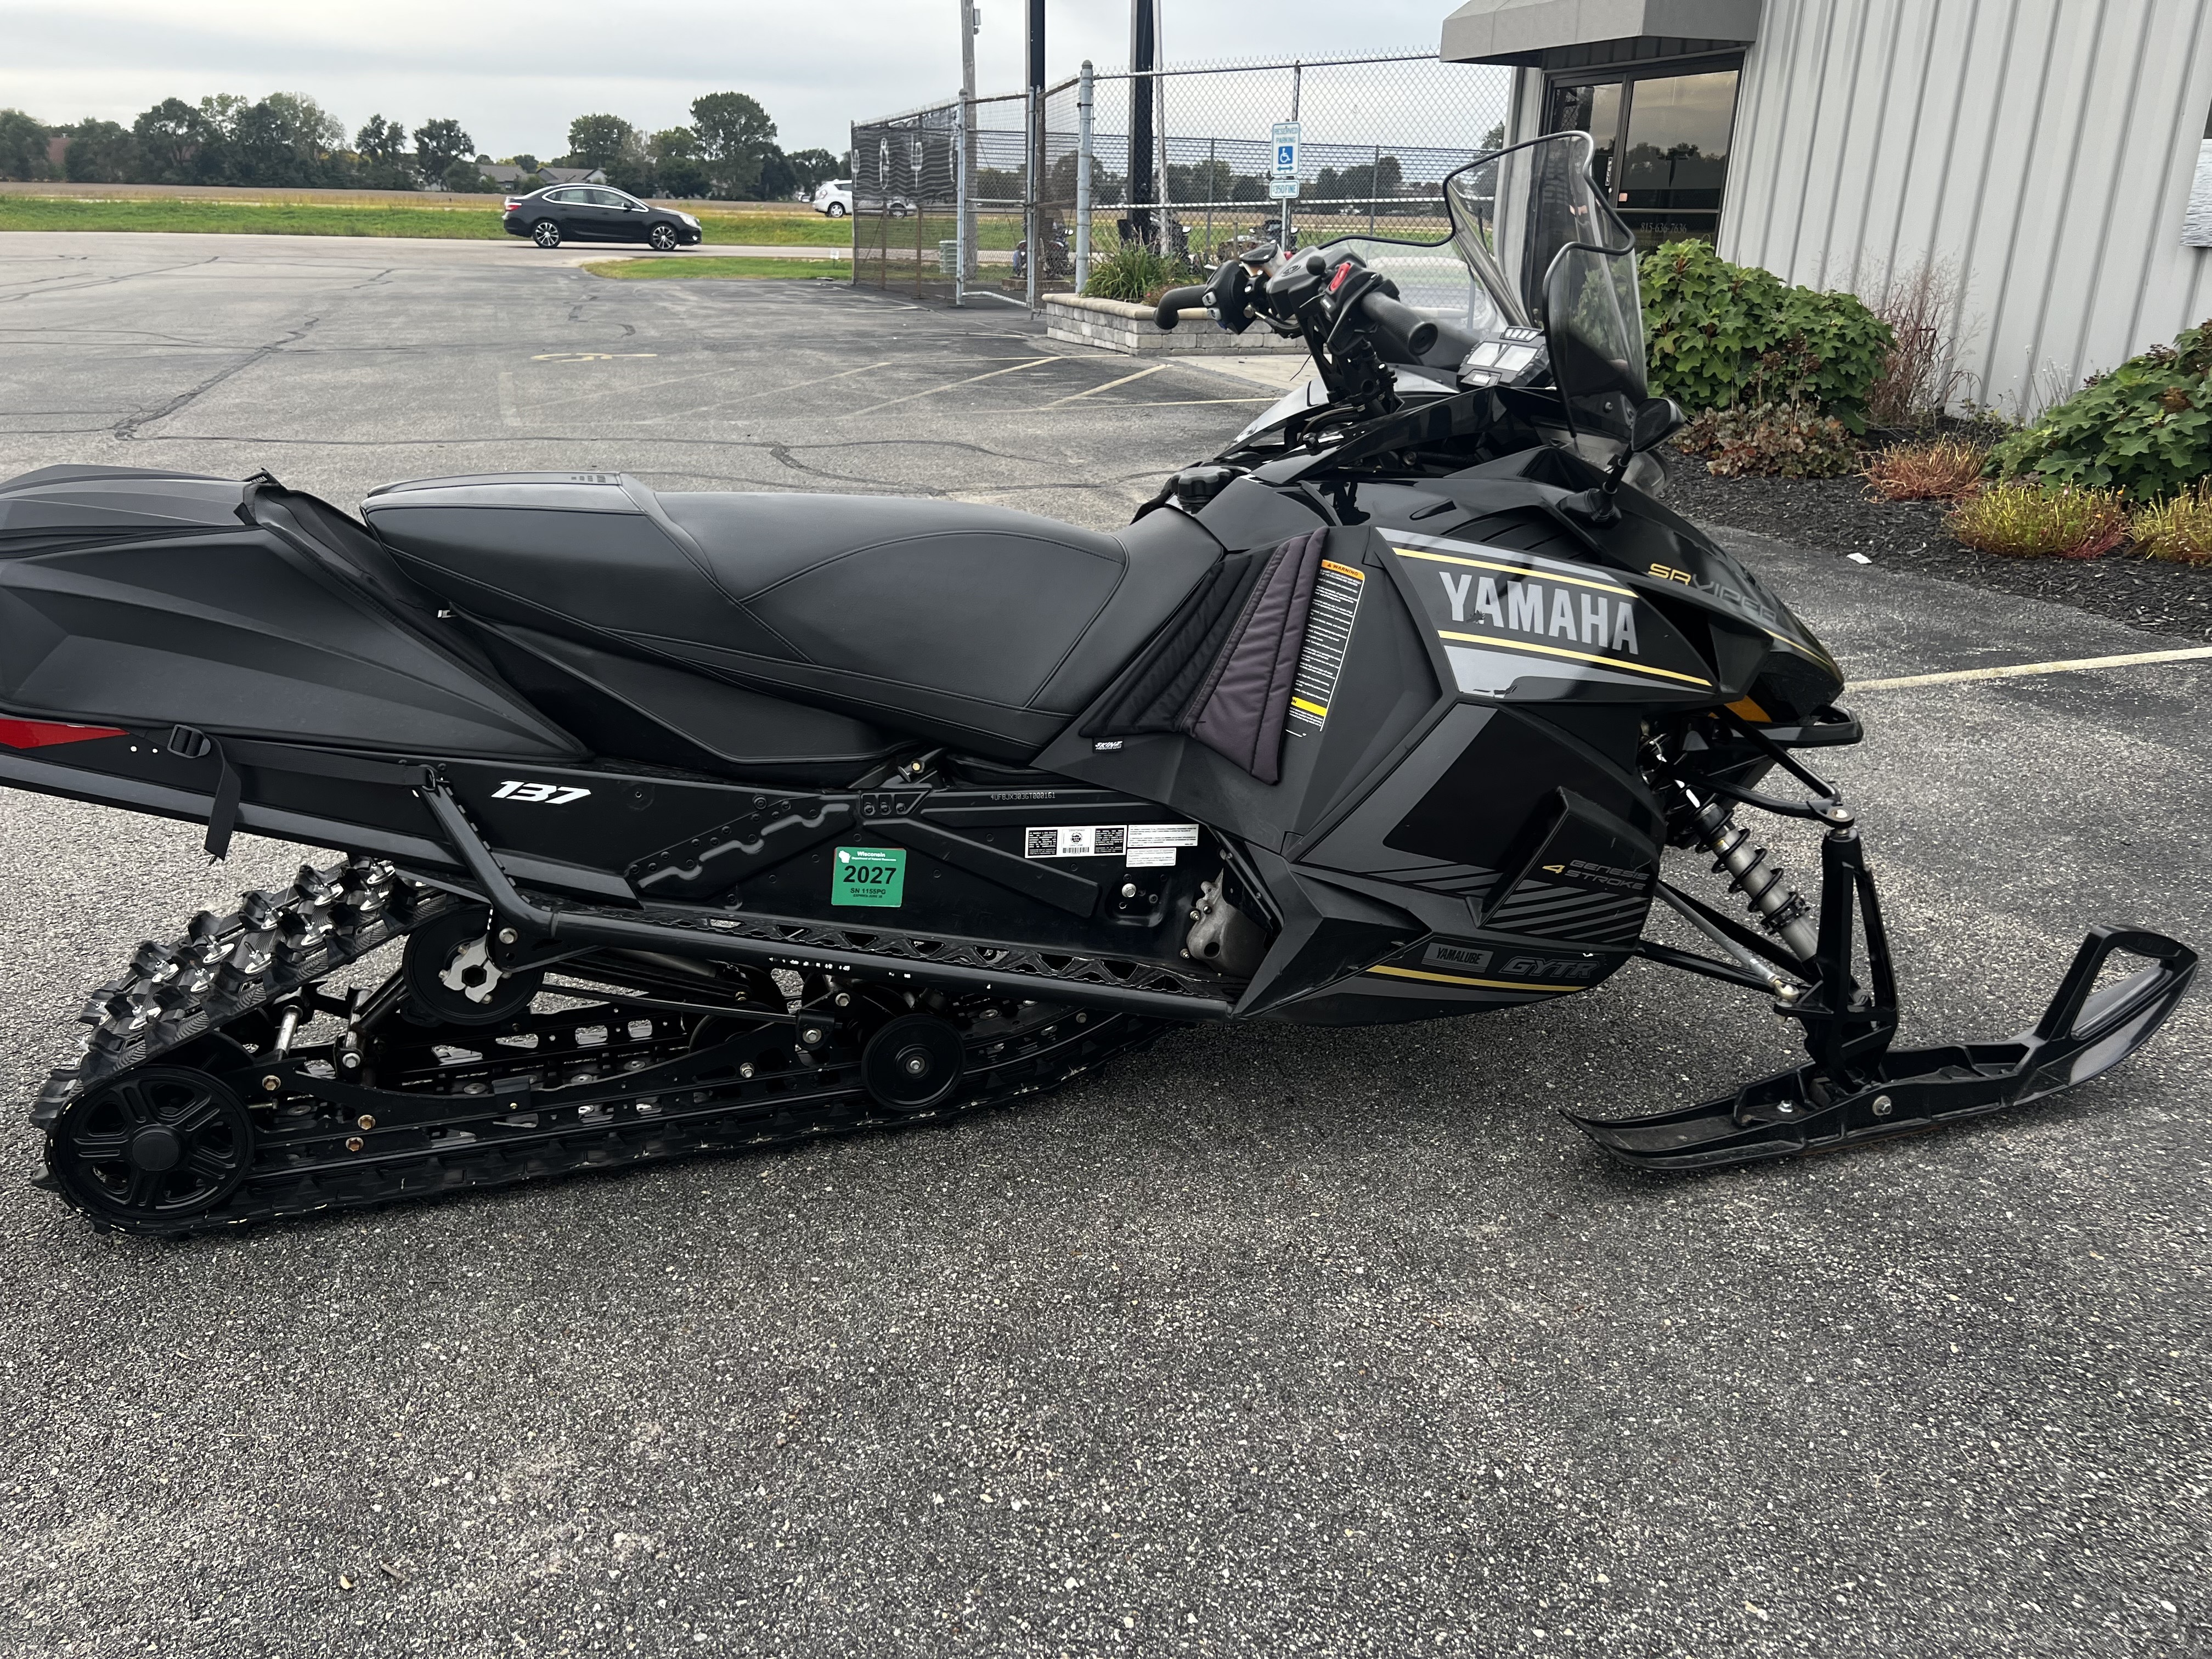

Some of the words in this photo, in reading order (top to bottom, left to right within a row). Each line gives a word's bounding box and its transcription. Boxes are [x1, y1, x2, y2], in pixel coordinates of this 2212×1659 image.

[1285, 184, 1296, 194] FINE
[1640, 222, 1687, 234] 815-636-7636
[1333, 565, 1358, 576] WARNING
[1438, 571, 1639, 655] YAMAHA
[491, 781, 591, 804] 137
[843, 865, 896, 884] 2027
[1542, 864, 1565, 874] 4
[1565, 870, 1646, 890] STROKE
[1570, 859, 1650, 881] GENESIS
[1436, 947, 1483, 965] YAMALUBE
[1499, 956, 1600, 978] GYTR
